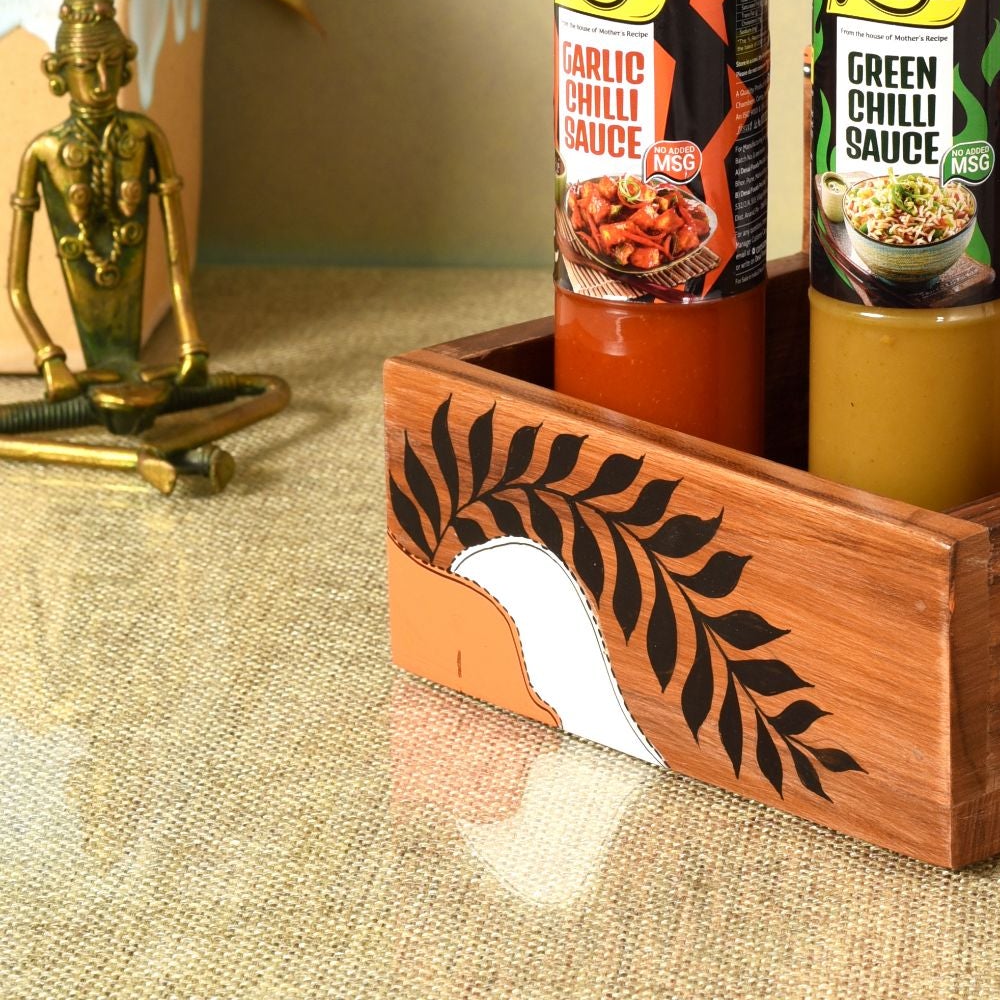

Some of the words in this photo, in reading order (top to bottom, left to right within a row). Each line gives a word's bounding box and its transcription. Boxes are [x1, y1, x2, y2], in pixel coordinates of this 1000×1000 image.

[626, 30, 649, 39] Recipe
[840, 28, 855, 36] From
[925, 35, 948, 43] Recipe
[562, 41, 645, 85] GARLIC
[847, 51, 937, 89] GREEN
[565, 79, 639, 122] CHILLI
[848, 88, 936, 127] CHILLI
[564, 116, 642, 159] SAUCE
[654, 146, 667, 154] NO
[668, 145, 695, 154] ADDED
[845, 126, 940, 165] SAUCE
[951, 149, 964, 157] NO
[965, 146, 990, 156] ADDED
[653, 153, 696, 172] MSG
[951, 154, 990, 175] MSG
